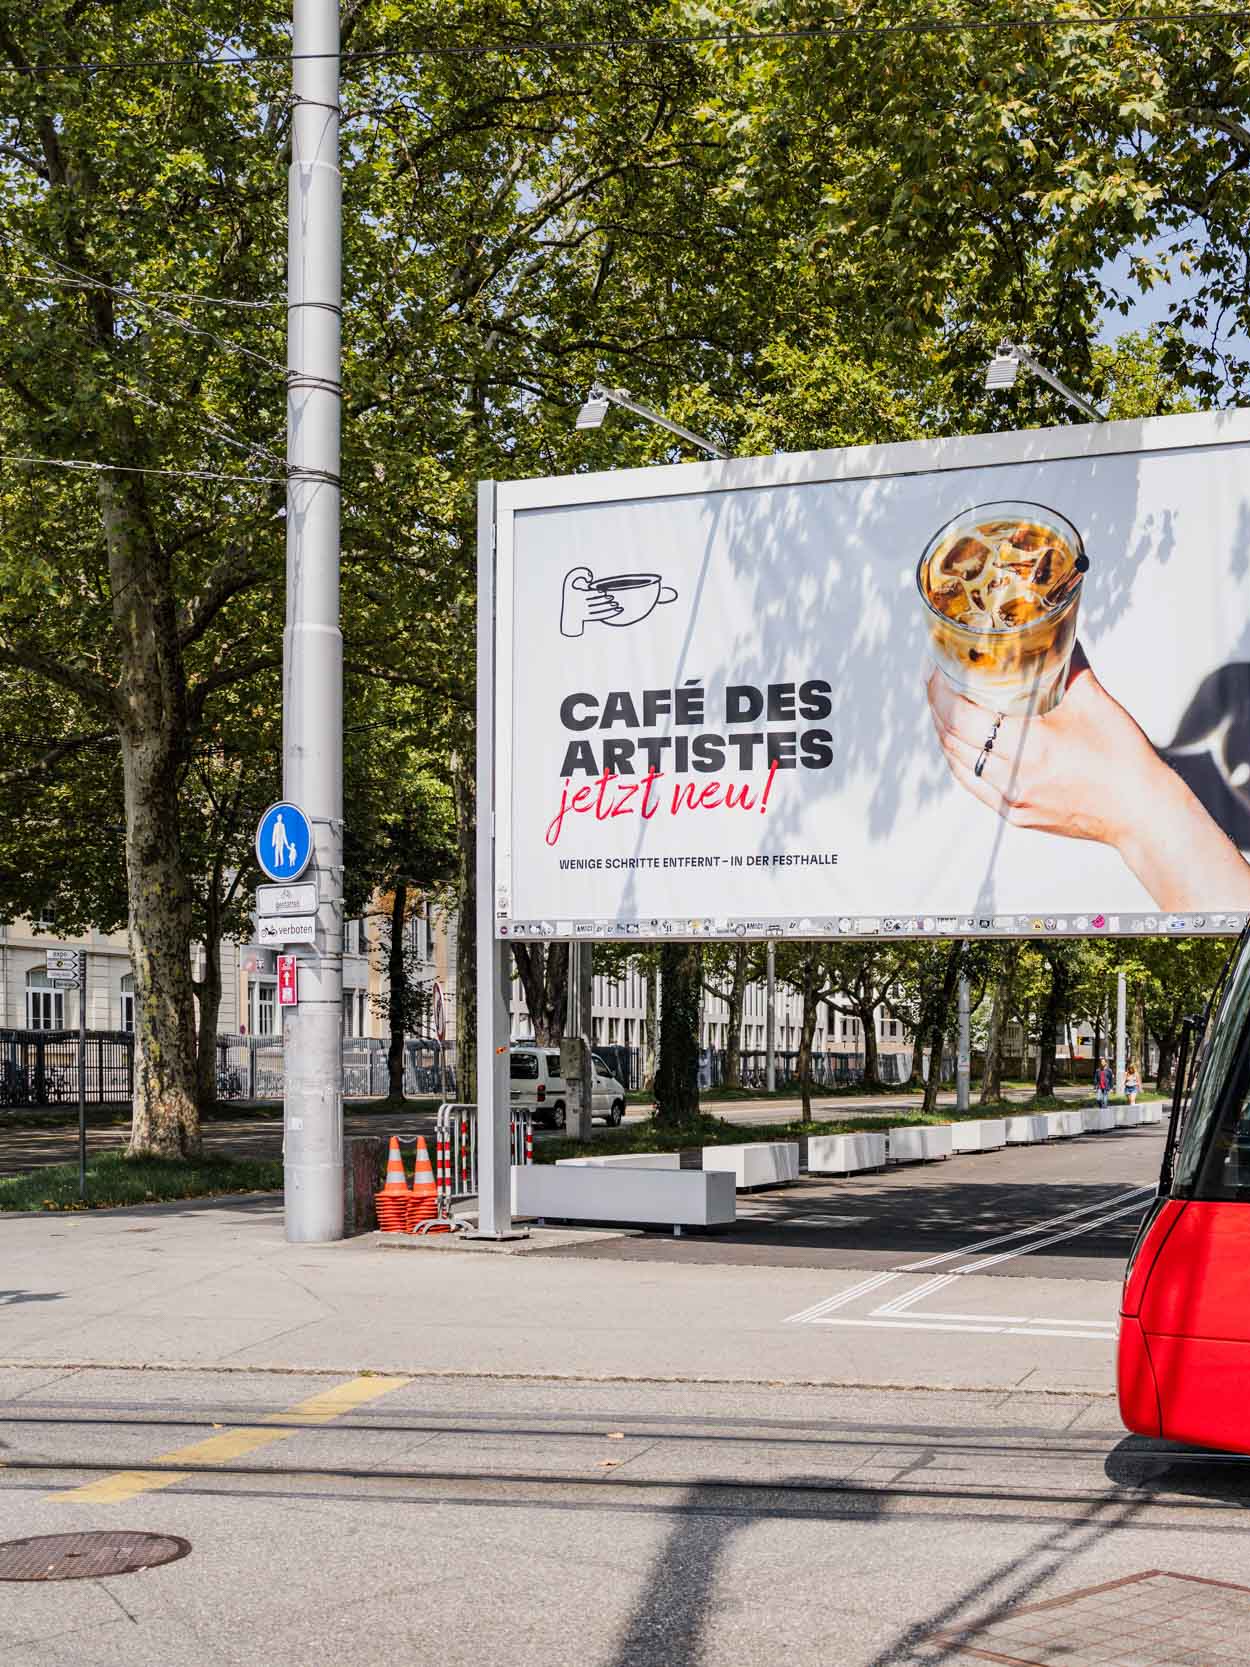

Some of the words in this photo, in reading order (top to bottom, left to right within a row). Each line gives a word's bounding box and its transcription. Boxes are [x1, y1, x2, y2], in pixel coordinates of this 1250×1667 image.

[559, 679, 705, 732] CAFÉ
[725, 679, 833, 724] DES
[559, 728, 834, 778] ARTISTES
[545, 764, 665, 847] jetzt
[670, 759, 779, 816] neu!
[559, 858, 603, 870] WENIGE
[604, 857, 660, 870] SCHRITTE
[745, 855, 769, 867] DER
[772, 854, 839, 866] FESTHALLE
[278, 925, 313, 936] verboten
